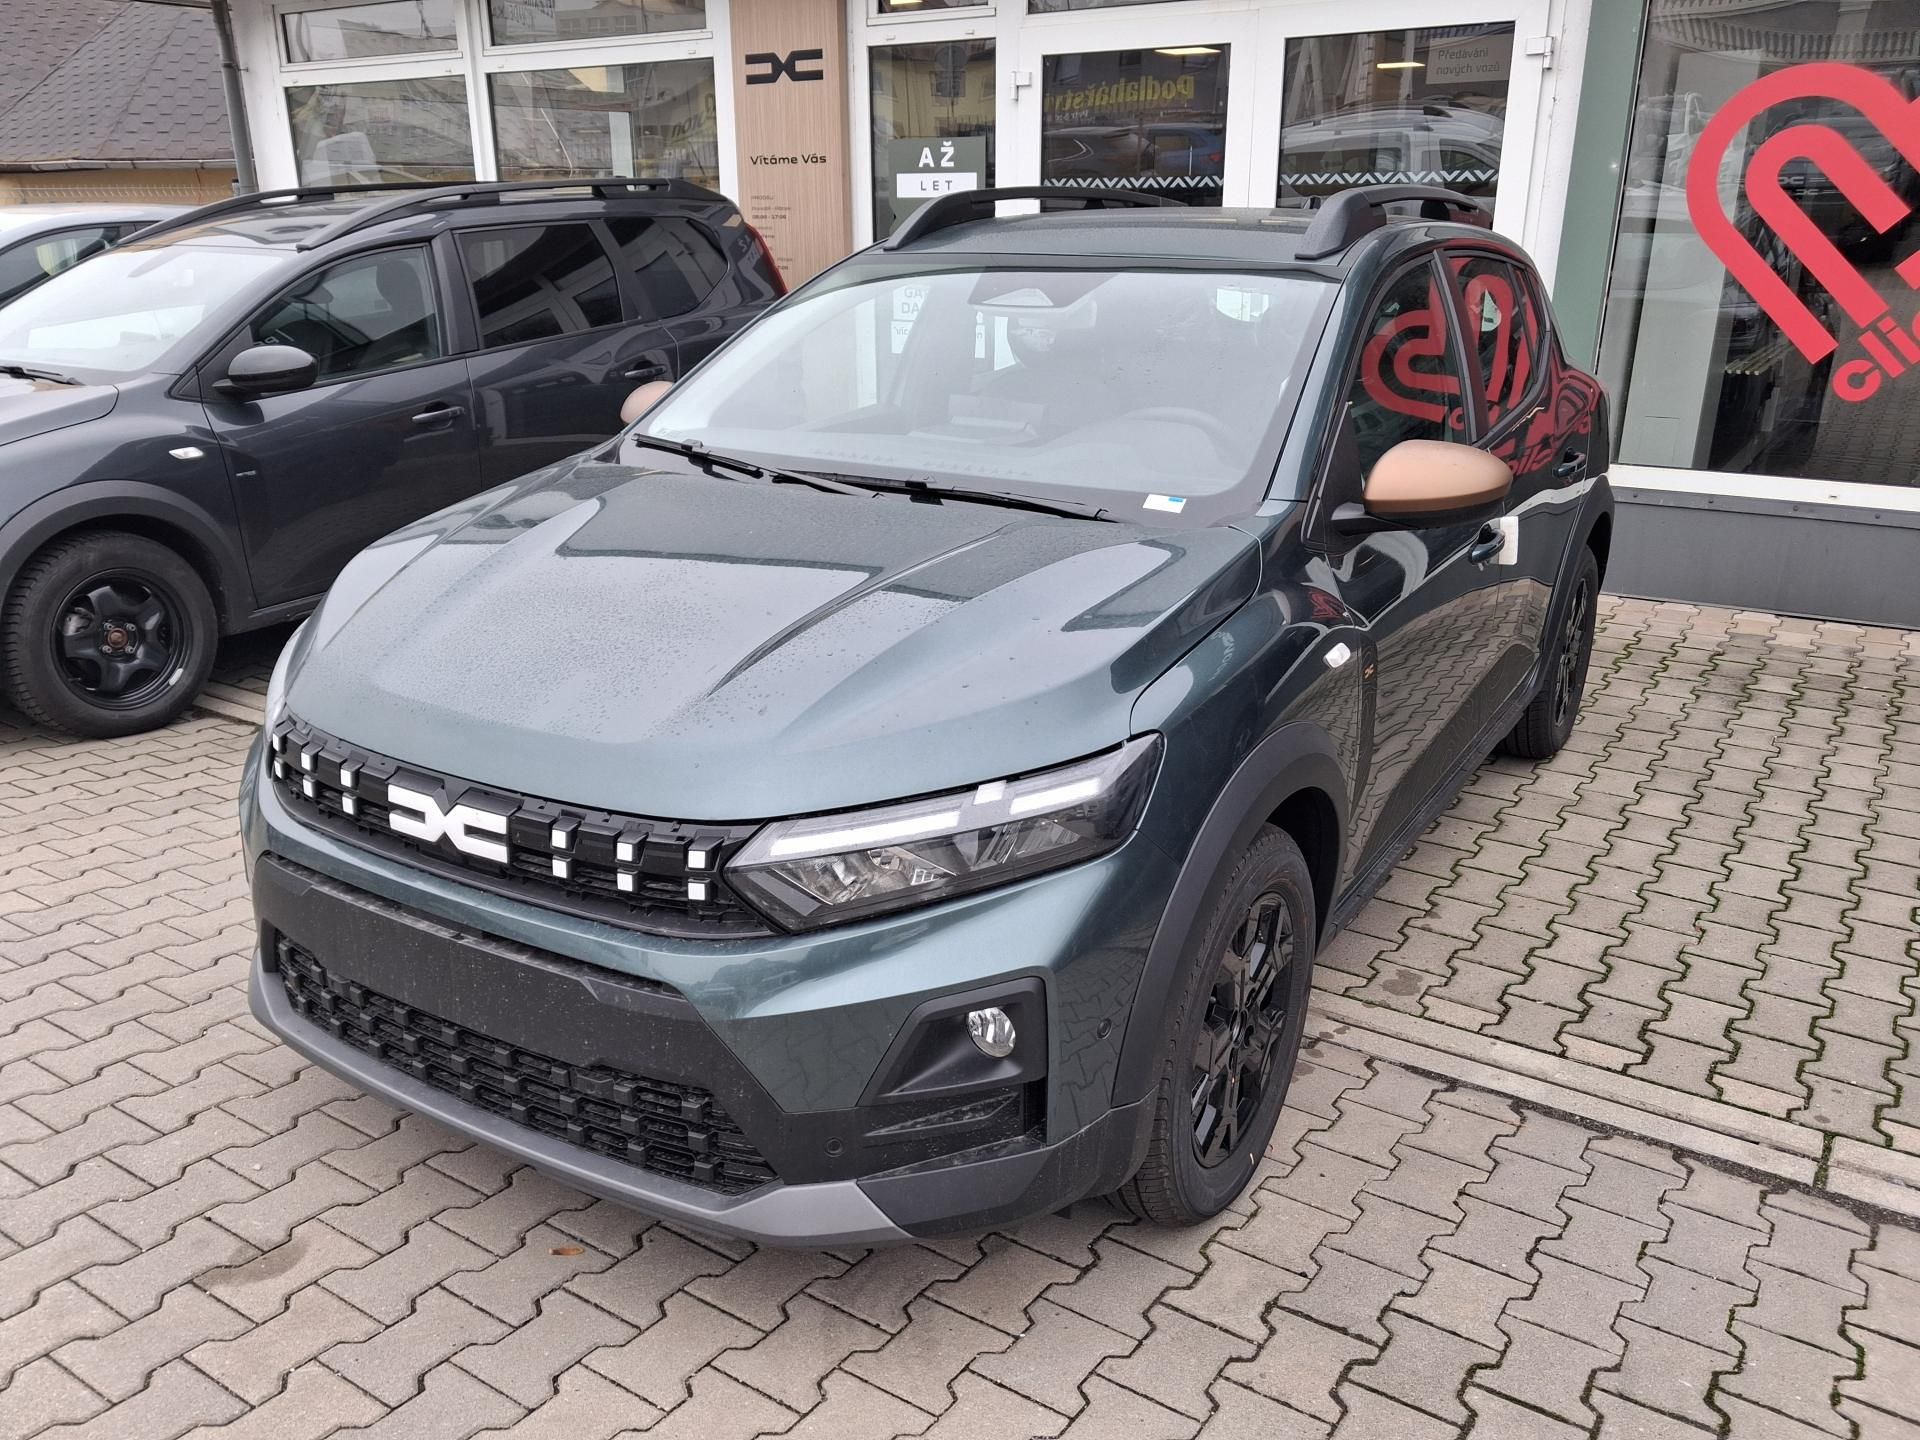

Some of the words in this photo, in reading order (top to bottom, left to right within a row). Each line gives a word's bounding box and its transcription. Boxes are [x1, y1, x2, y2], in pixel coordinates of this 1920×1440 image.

[750, 153, 798, 165] Vítáme
[801, 152, 827, 164] Vás
[918, 140, 955, 168] AŽ
[920, 180, 953, 191] LET
[1832, 311, 1920, 402] cli
